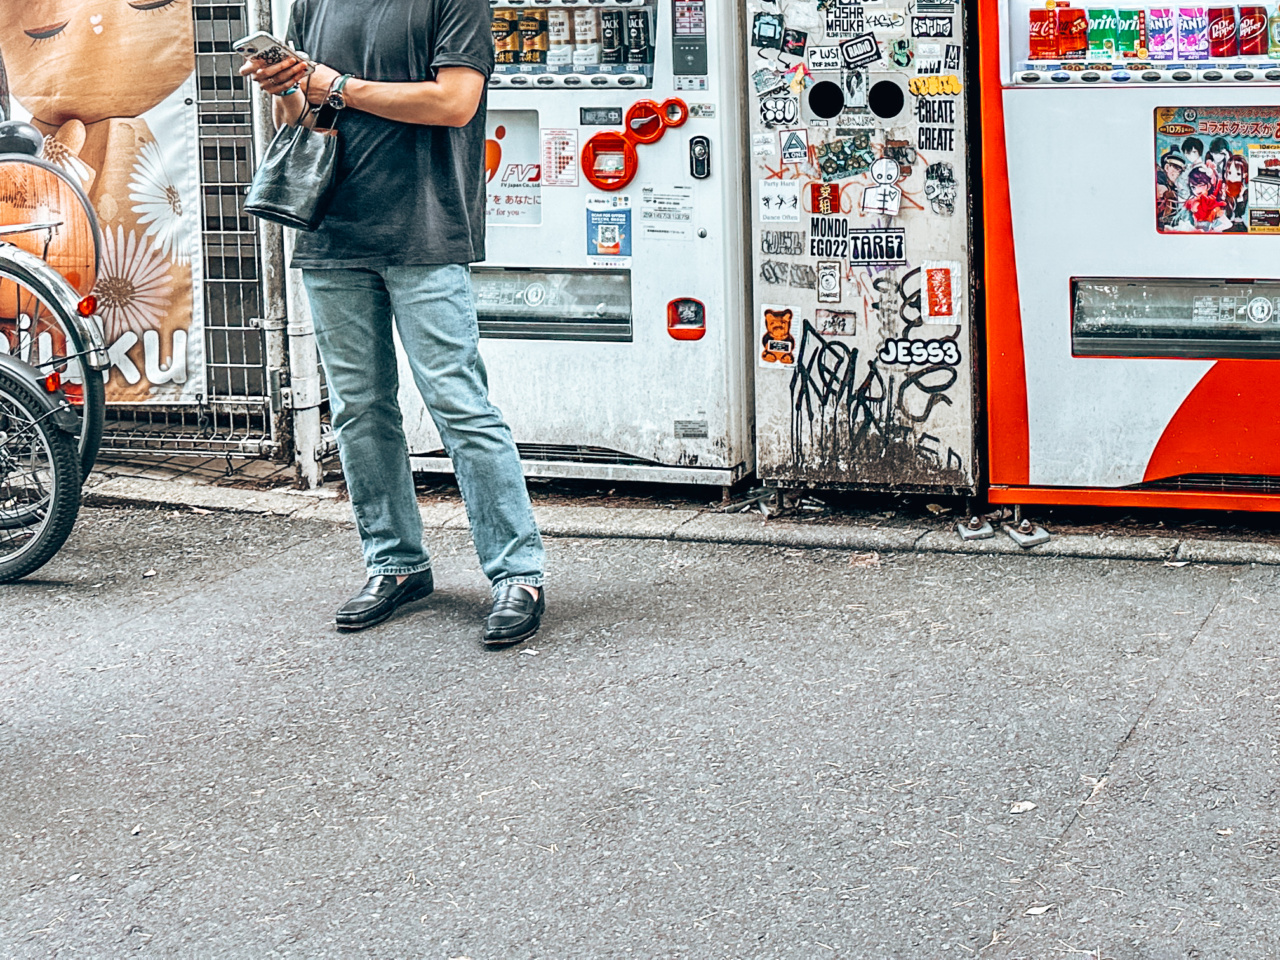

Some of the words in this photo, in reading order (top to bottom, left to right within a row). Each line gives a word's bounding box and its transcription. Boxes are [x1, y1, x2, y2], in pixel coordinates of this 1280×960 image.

[1088, 14, 1116, 32] prite
[918, 99, 955, 124] CREATE
[918, 127, 954, 152] CREATE
[811, 217, 848, 238] MONDO
[811, 239, 848, 257] EGO22
[879, 342, 960, 364] JESS3
